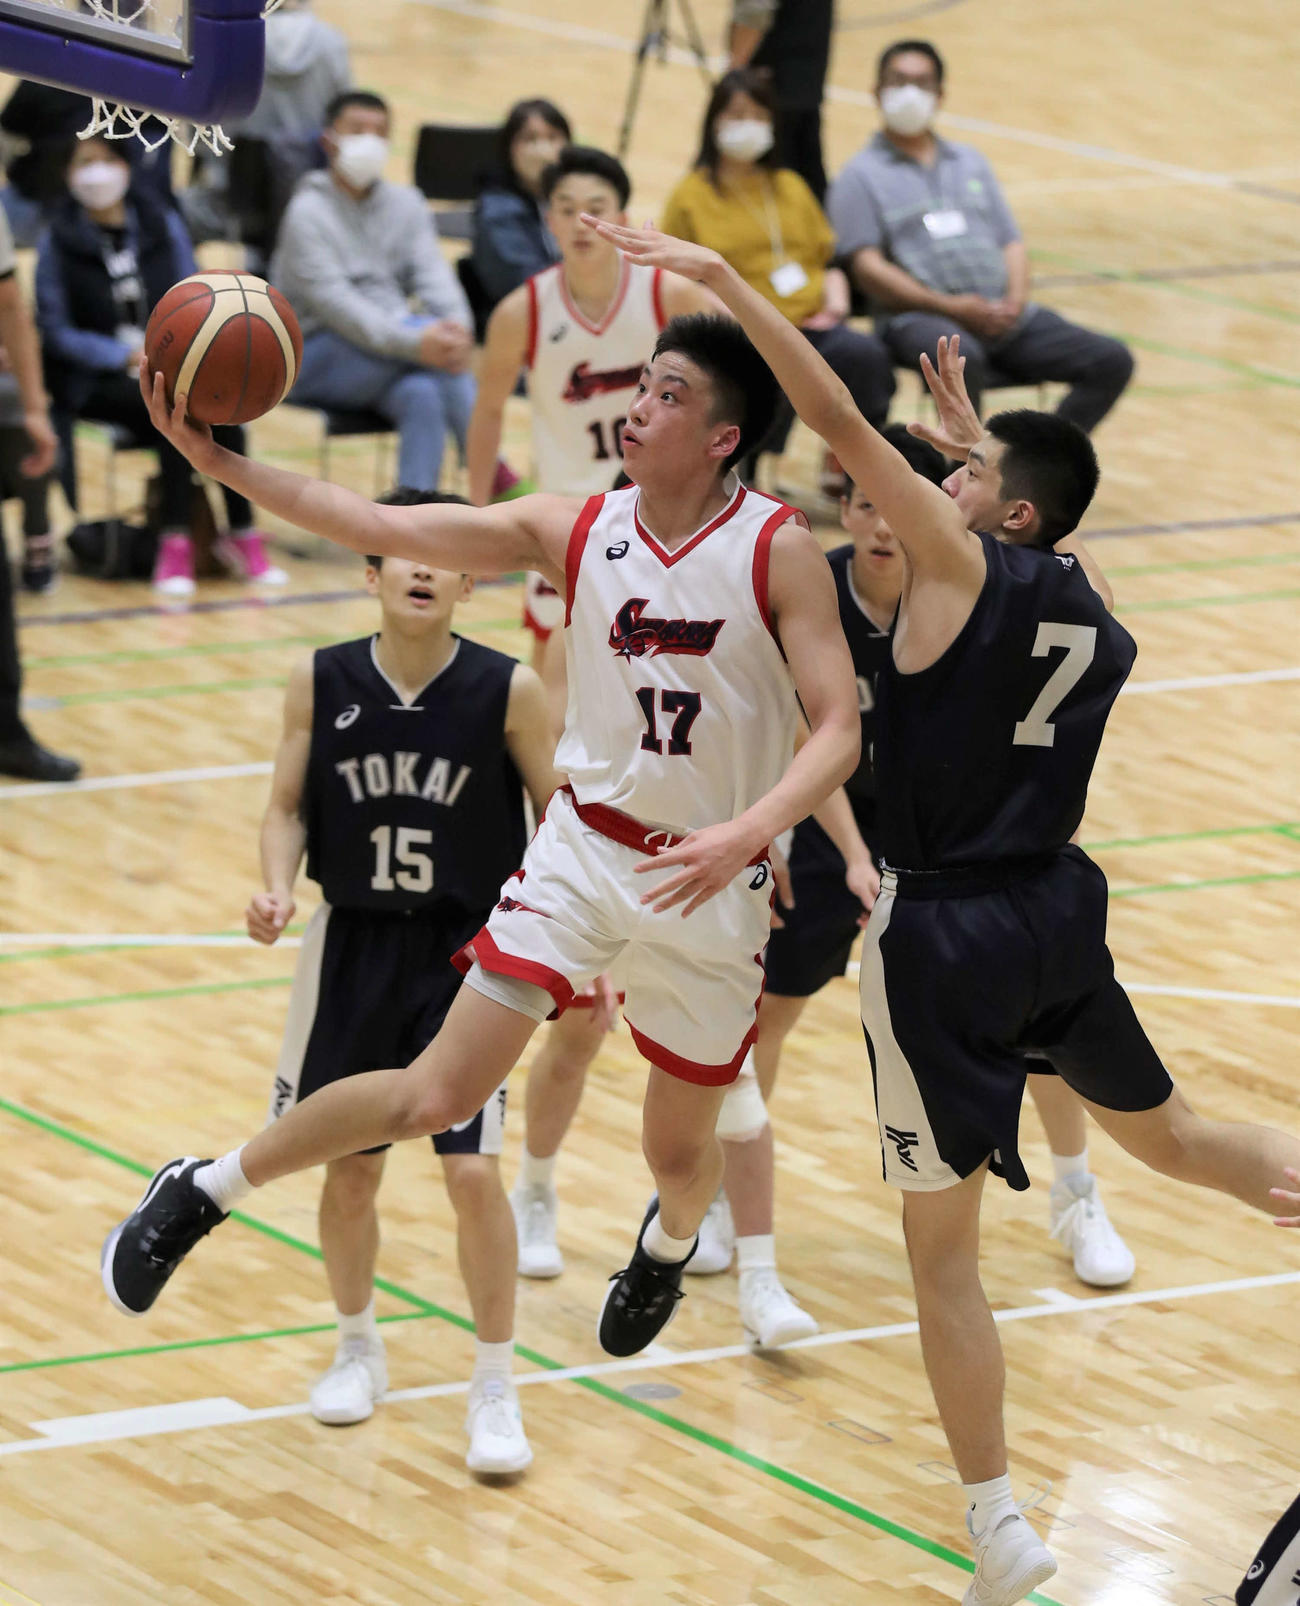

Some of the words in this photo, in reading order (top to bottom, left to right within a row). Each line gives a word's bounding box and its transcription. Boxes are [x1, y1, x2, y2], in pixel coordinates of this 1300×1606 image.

[1012, 621, 1098, 748] 7
[635, 686, 702, 756] 17
[334, 750, 473, 807] TOKAI
[370, 825, 434, 893] 15
